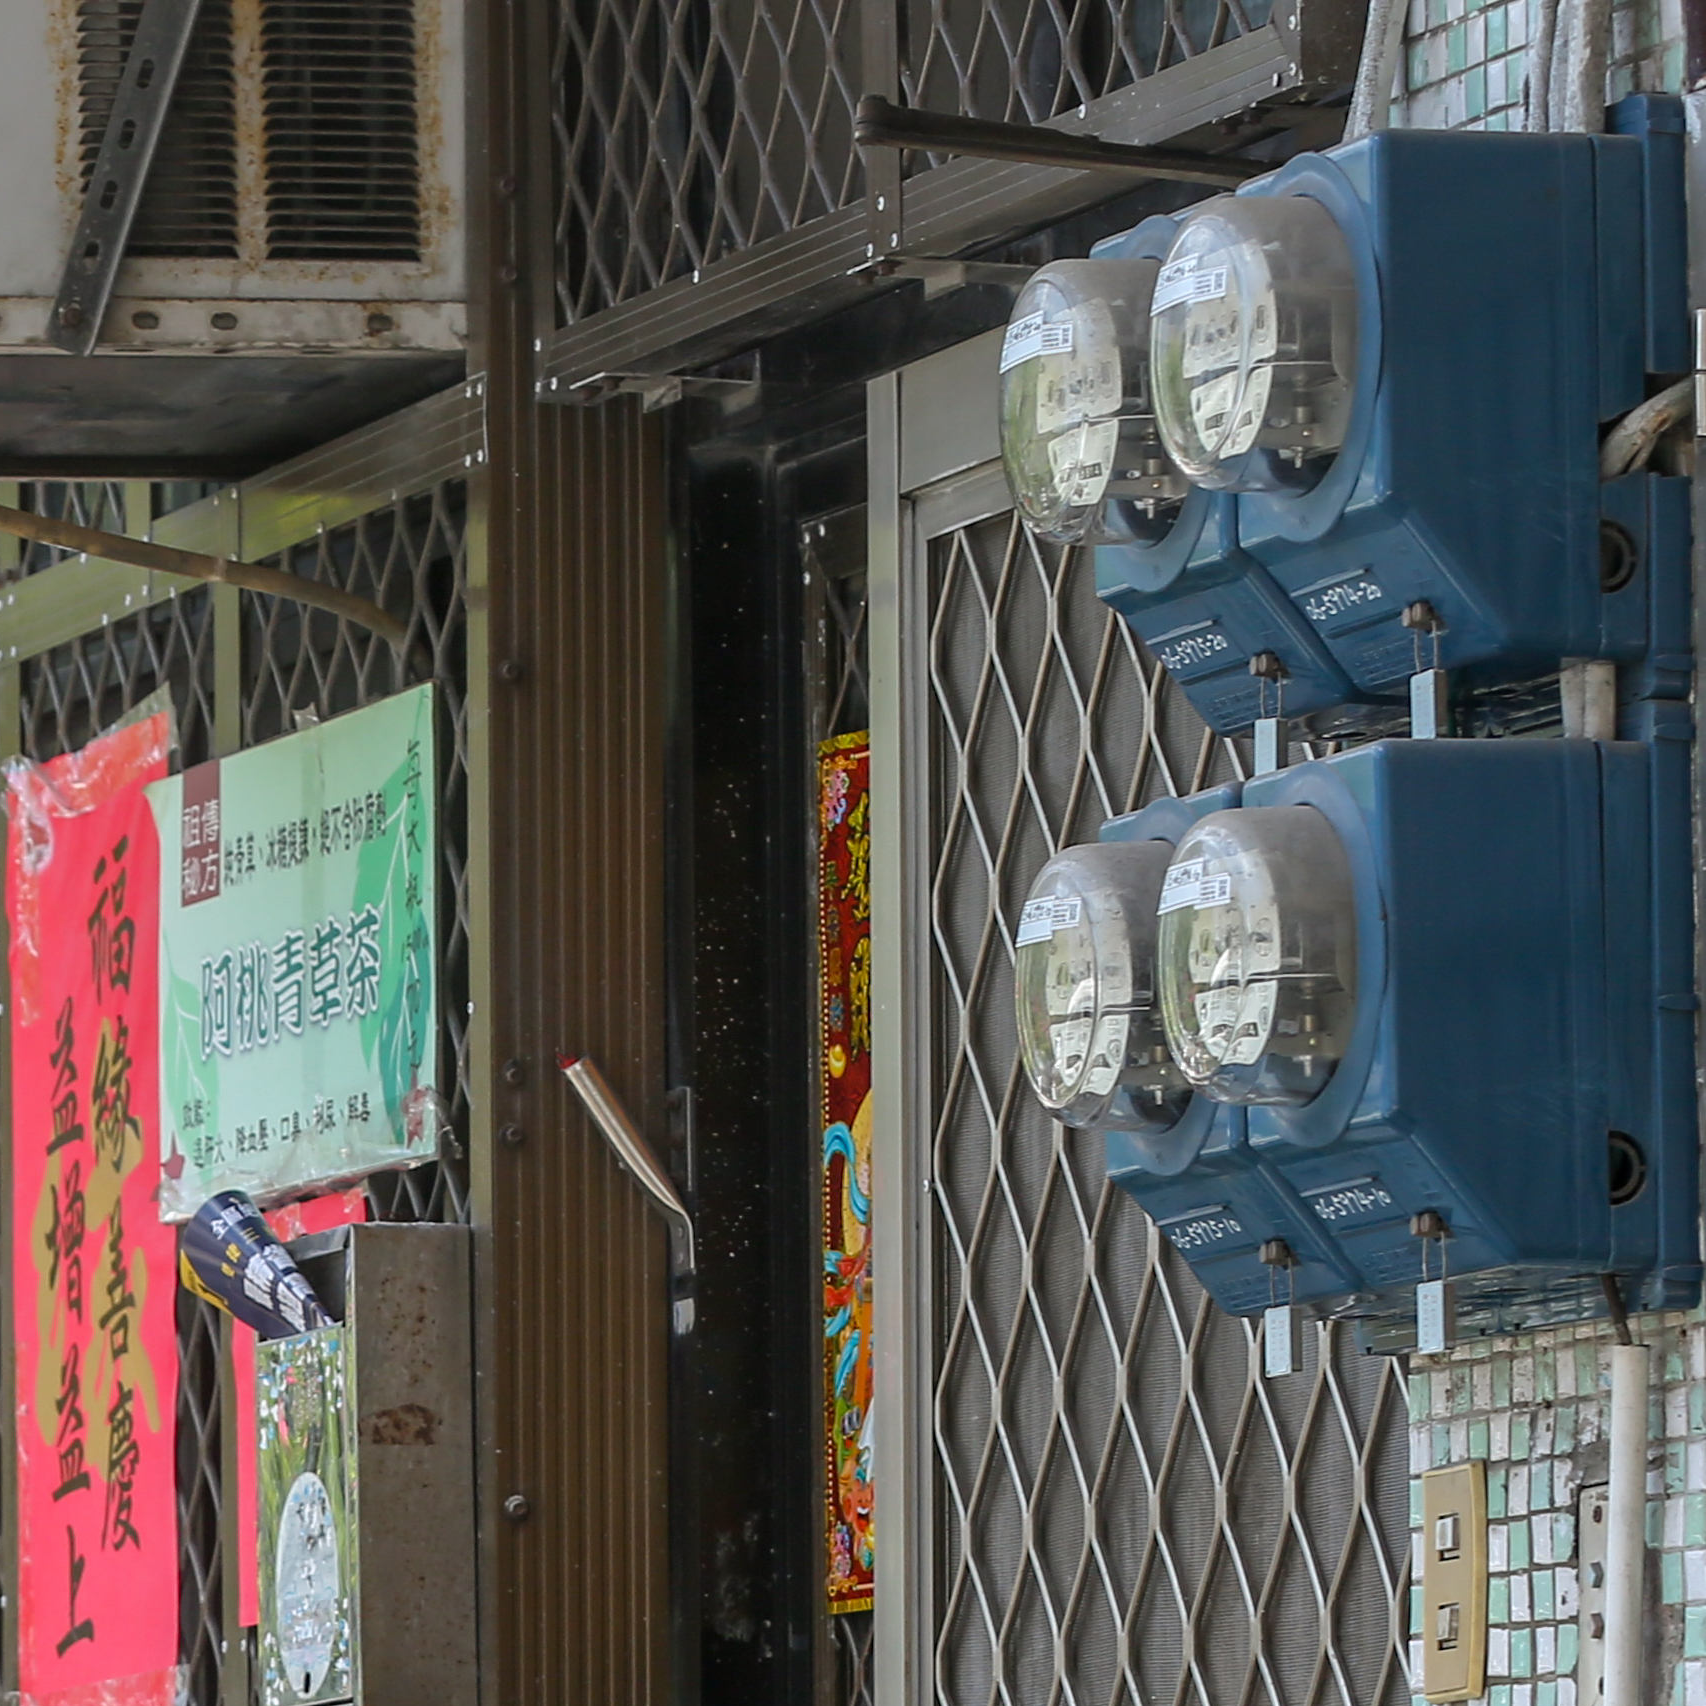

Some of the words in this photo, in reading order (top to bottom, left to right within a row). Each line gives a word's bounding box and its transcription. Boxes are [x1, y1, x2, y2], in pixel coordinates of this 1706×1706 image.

[1304, 581, 1382, 621] 06-5974-20
[1160, 633, 1228, 670] 06-5975-20
[201, 904, 380, 1062] 阿桃青草茶
[1314, 1187, 1392, 1220] 06-5974-10
[1170, 1217, 1242, 1250] 06-5975-10
